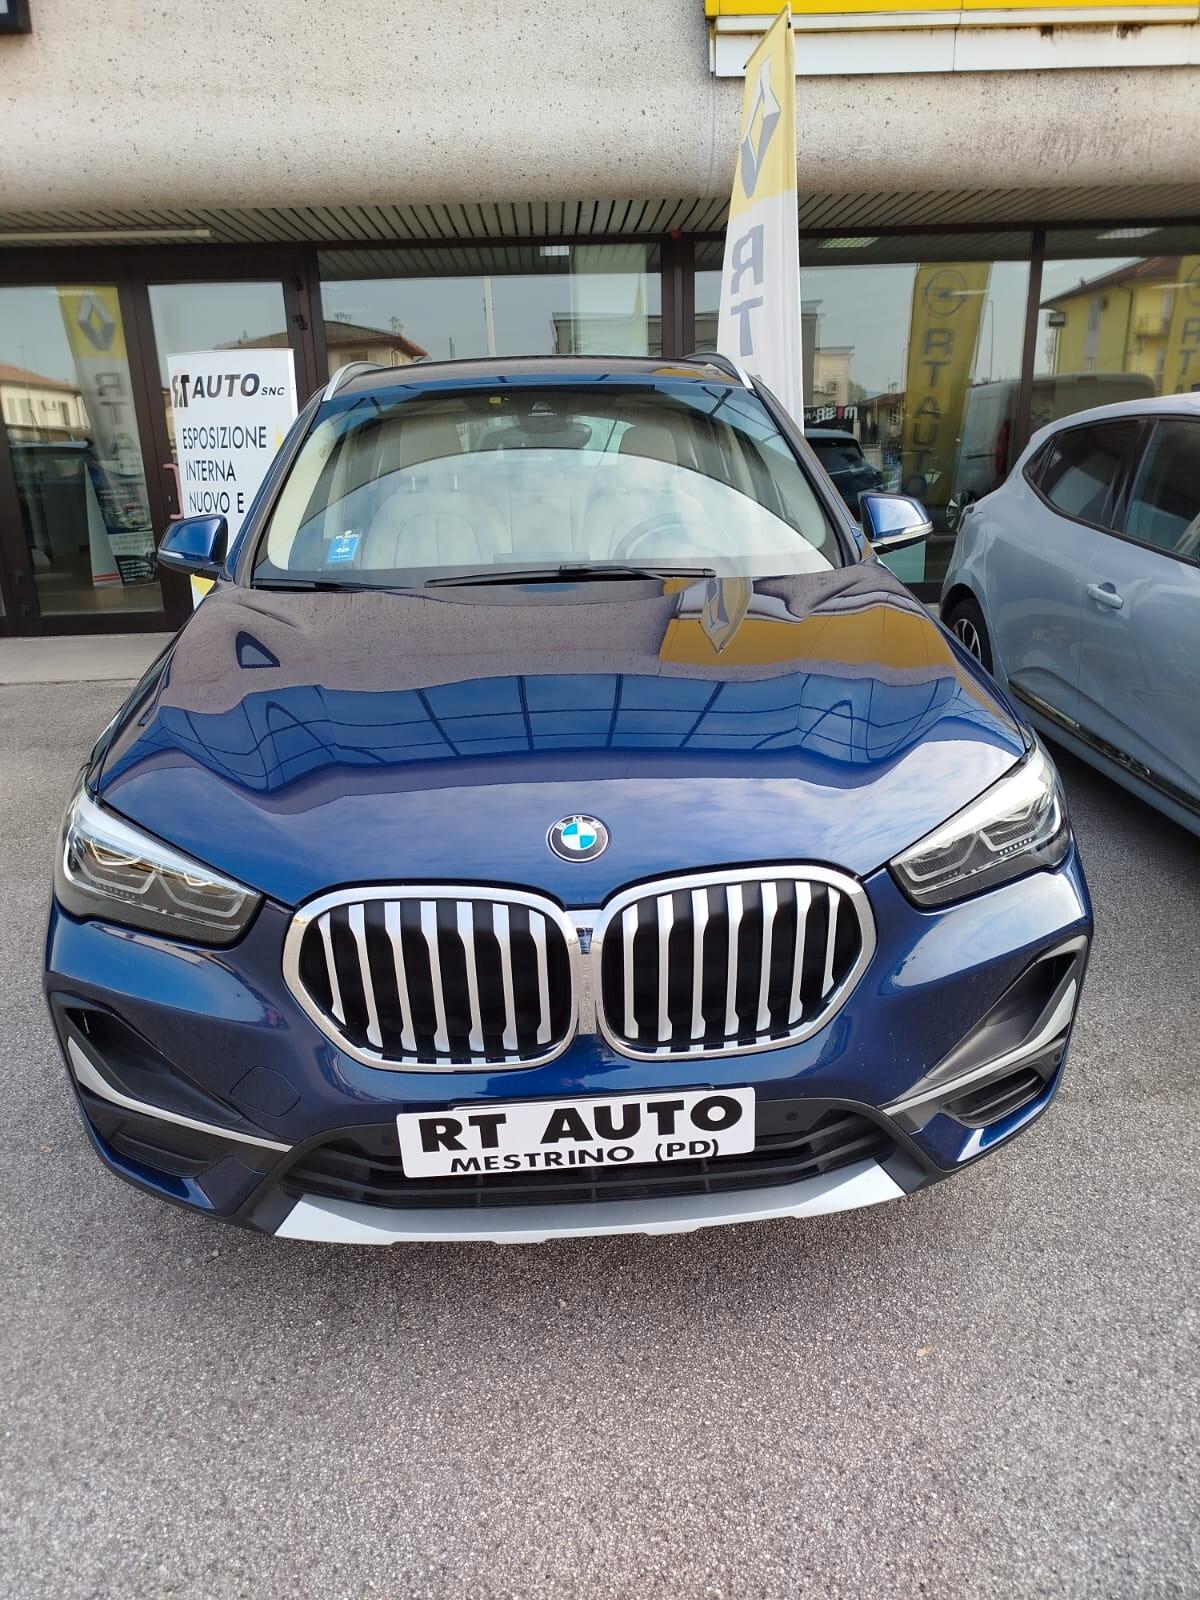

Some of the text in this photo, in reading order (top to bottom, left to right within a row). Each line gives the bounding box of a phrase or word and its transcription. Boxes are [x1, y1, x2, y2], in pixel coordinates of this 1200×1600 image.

[261, 386, 285, 396] SNC
[182, 426, 267, 450] ESPOSIZIONE
[186, 459, 237, 482] INTERNA
[189, 491, 244, 514] NUOVO E
[418, 1095, 743, 1153] RT AUTO
[450, 1138, 720, 1173] MESTRINO (PD)
